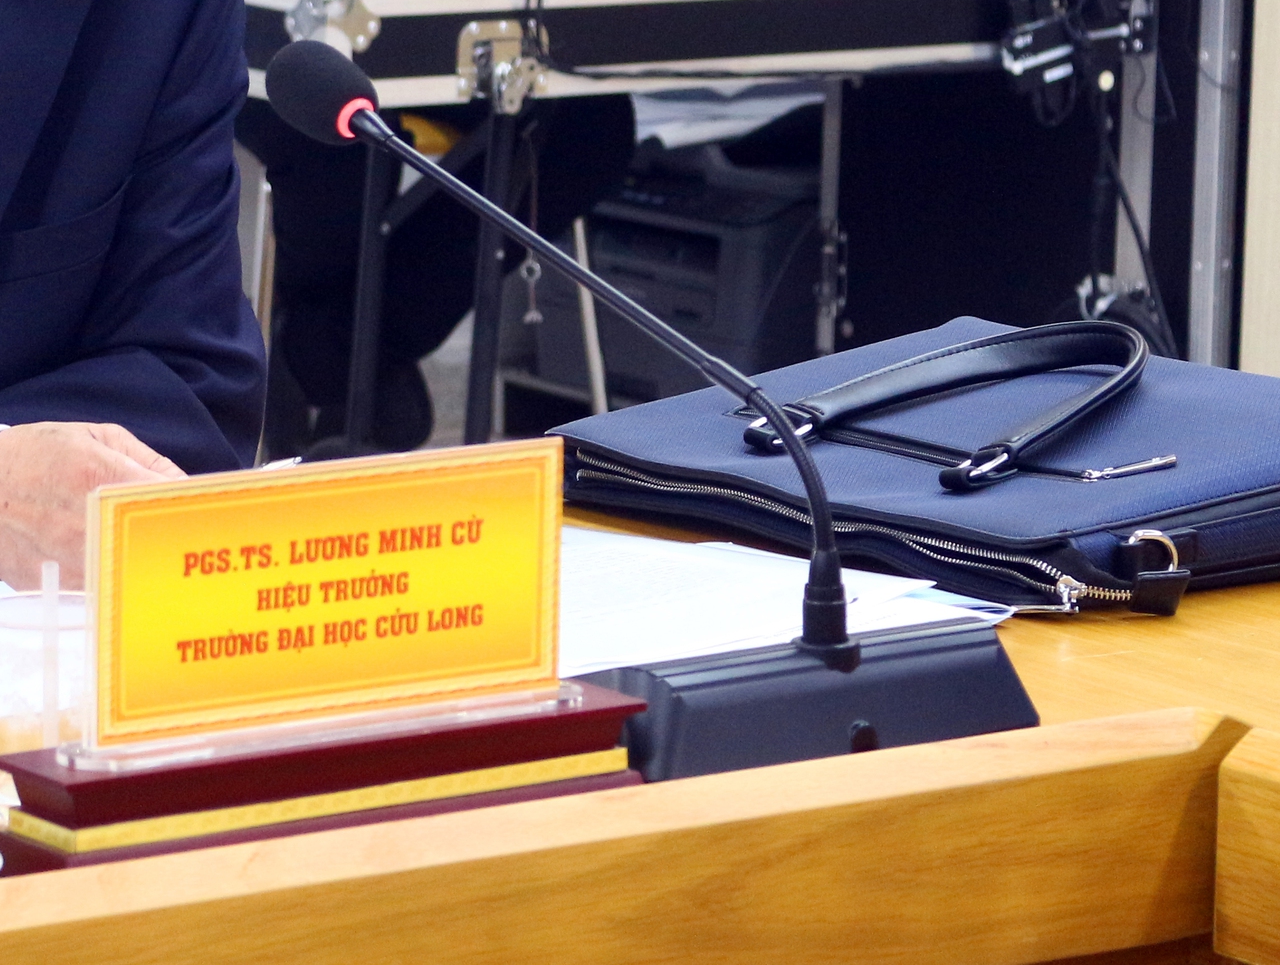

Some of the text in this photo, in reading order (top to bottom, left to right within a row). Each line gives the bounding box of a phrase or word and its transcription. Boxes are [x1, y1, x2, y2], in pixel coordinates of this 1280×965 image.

[183, 543, 279, 577] PGS.TS.
[289, 531, 370, 565] LƯƠNG
[378, 523, 443, 554] MINH
[257, 568, 410, 612] HIỆU TRƯỞNG
[177, 628, 269, 663] TRƯỜNG
[278, 625, 315, 654] ĐẠI
[323, 618, 368, 648] HỌC
[427, 603, 484, 632] LONG
